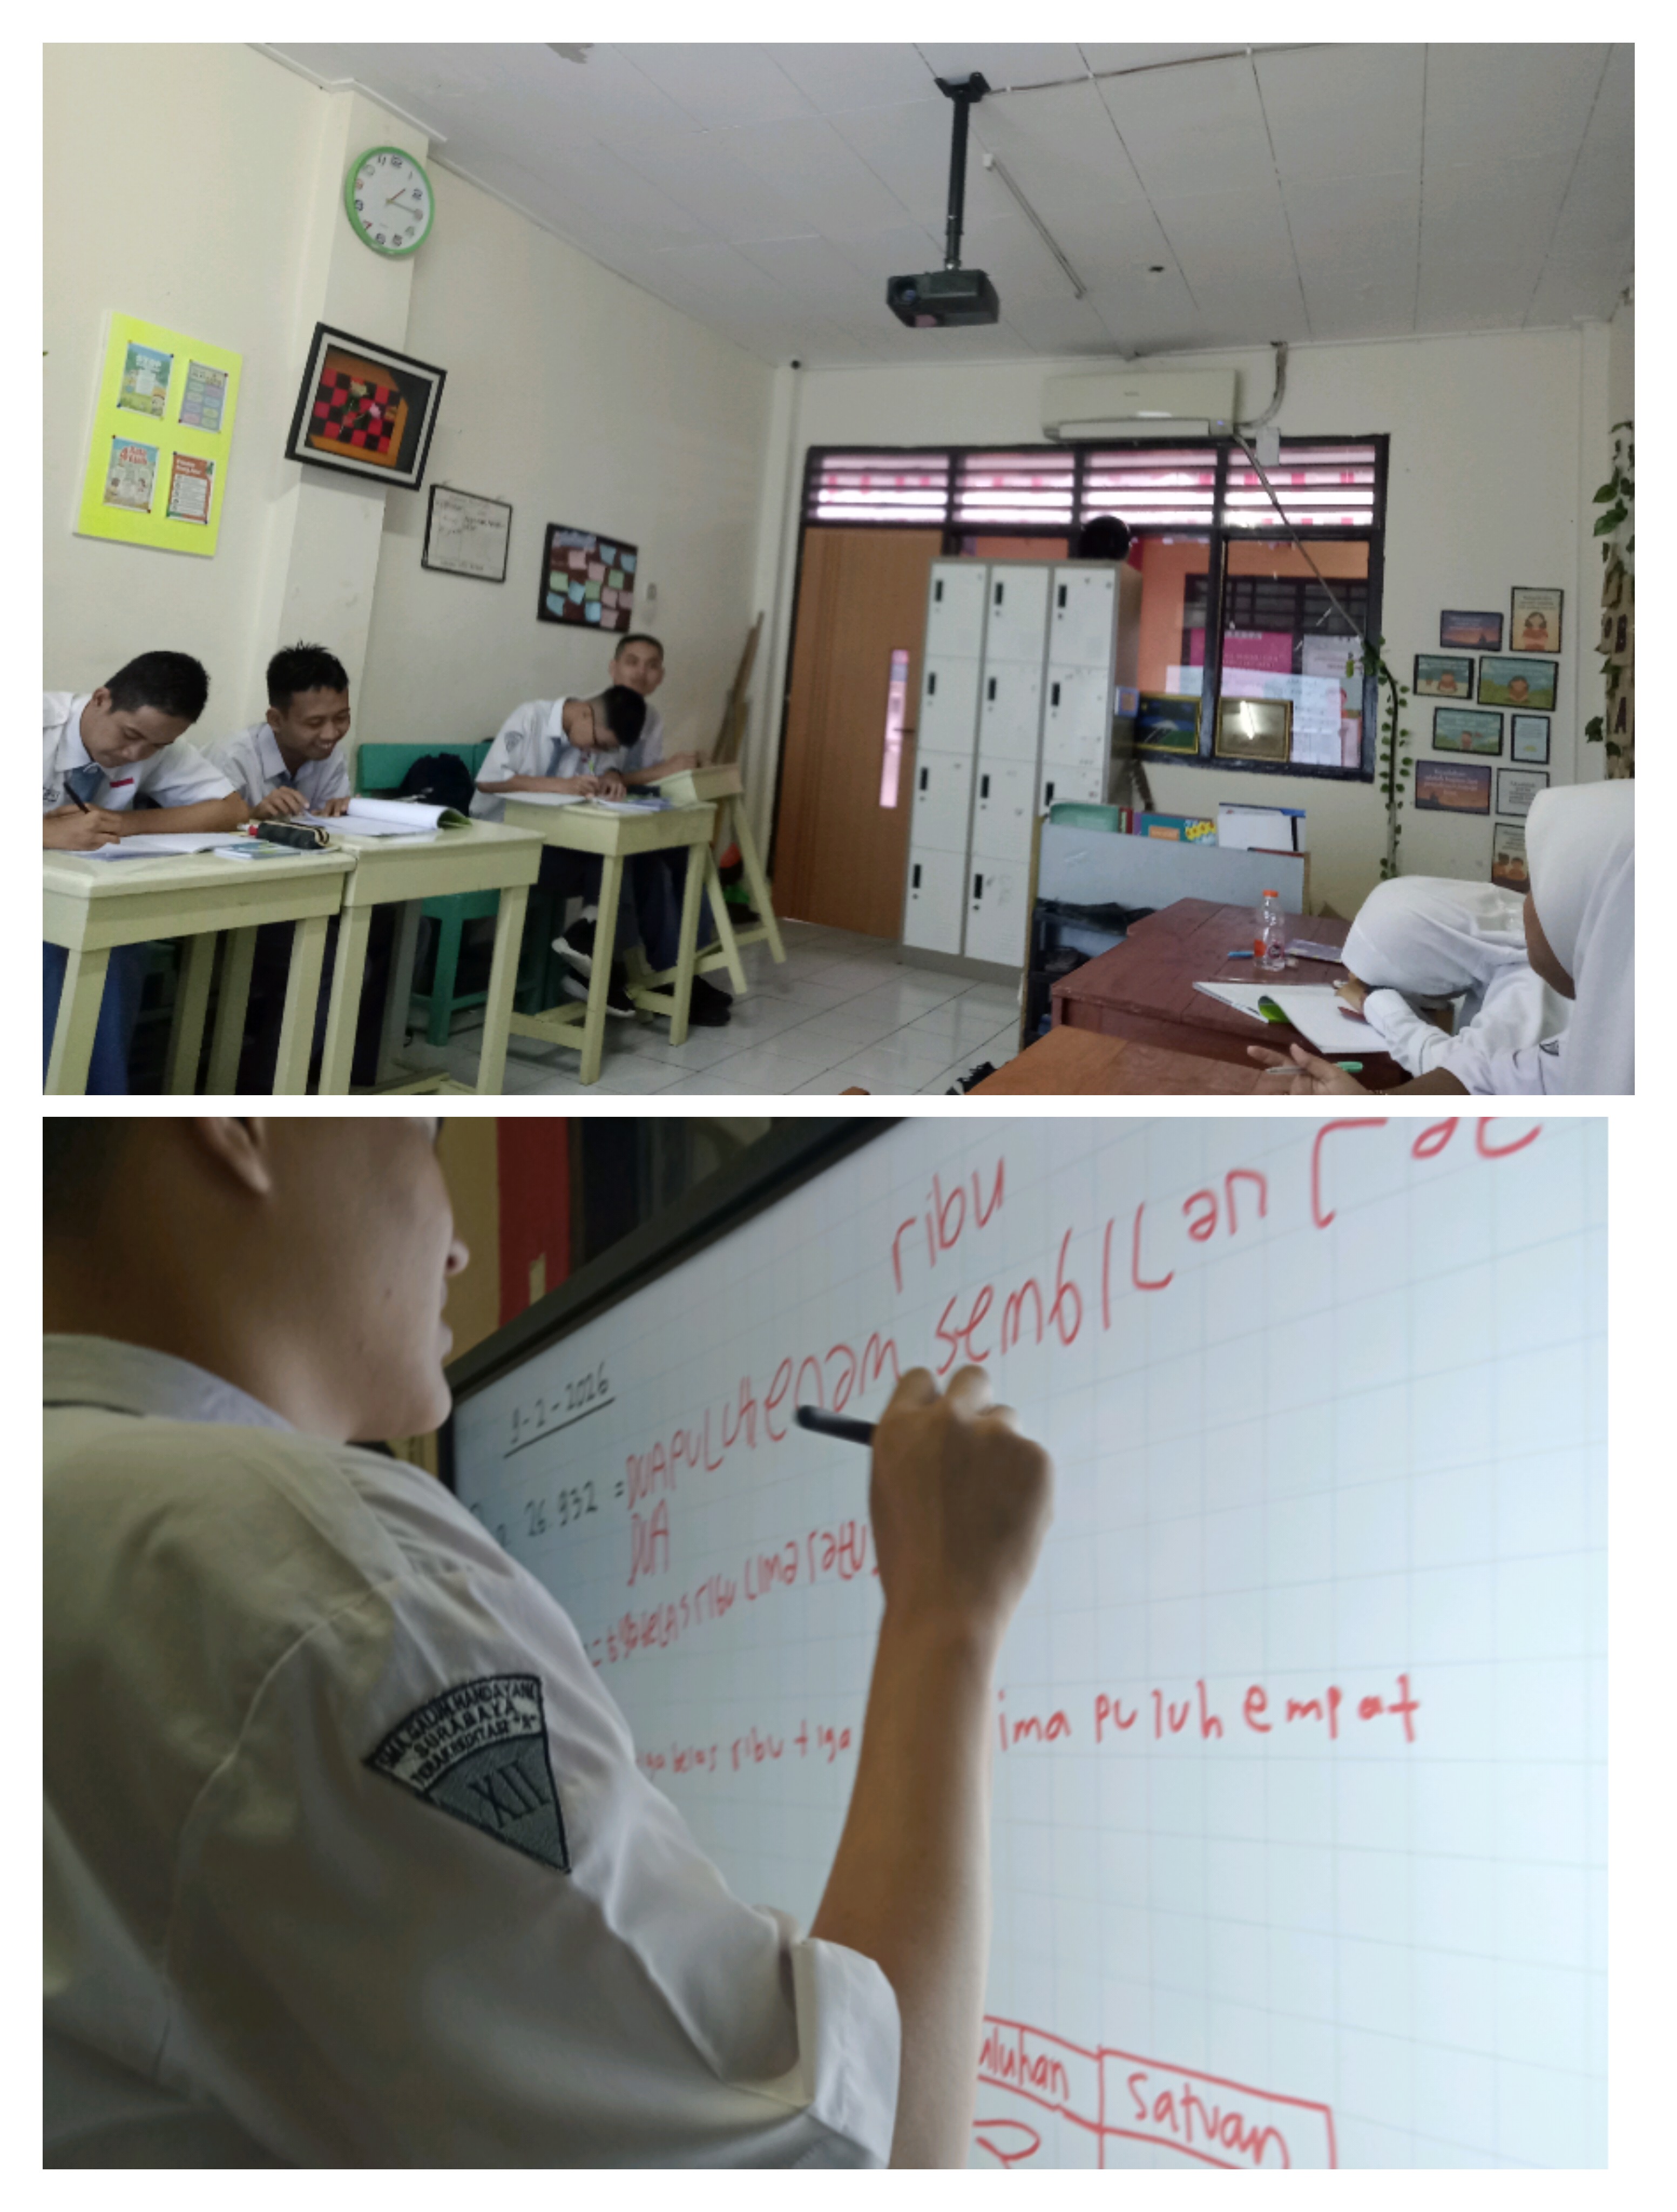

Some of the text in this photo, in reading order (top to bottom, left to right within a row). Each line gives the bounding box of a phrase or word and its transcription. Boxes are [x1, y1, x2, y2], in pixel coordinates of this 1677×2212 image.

[892, 1155, 1004, 1294] ribu
[414, 1698, 517, 1759] SURABAYA
[998, 1689, 1072, 1752] ima
[1242, 1673, 1421, 1744] empat
[467, 1760, 551, 1829] XII
